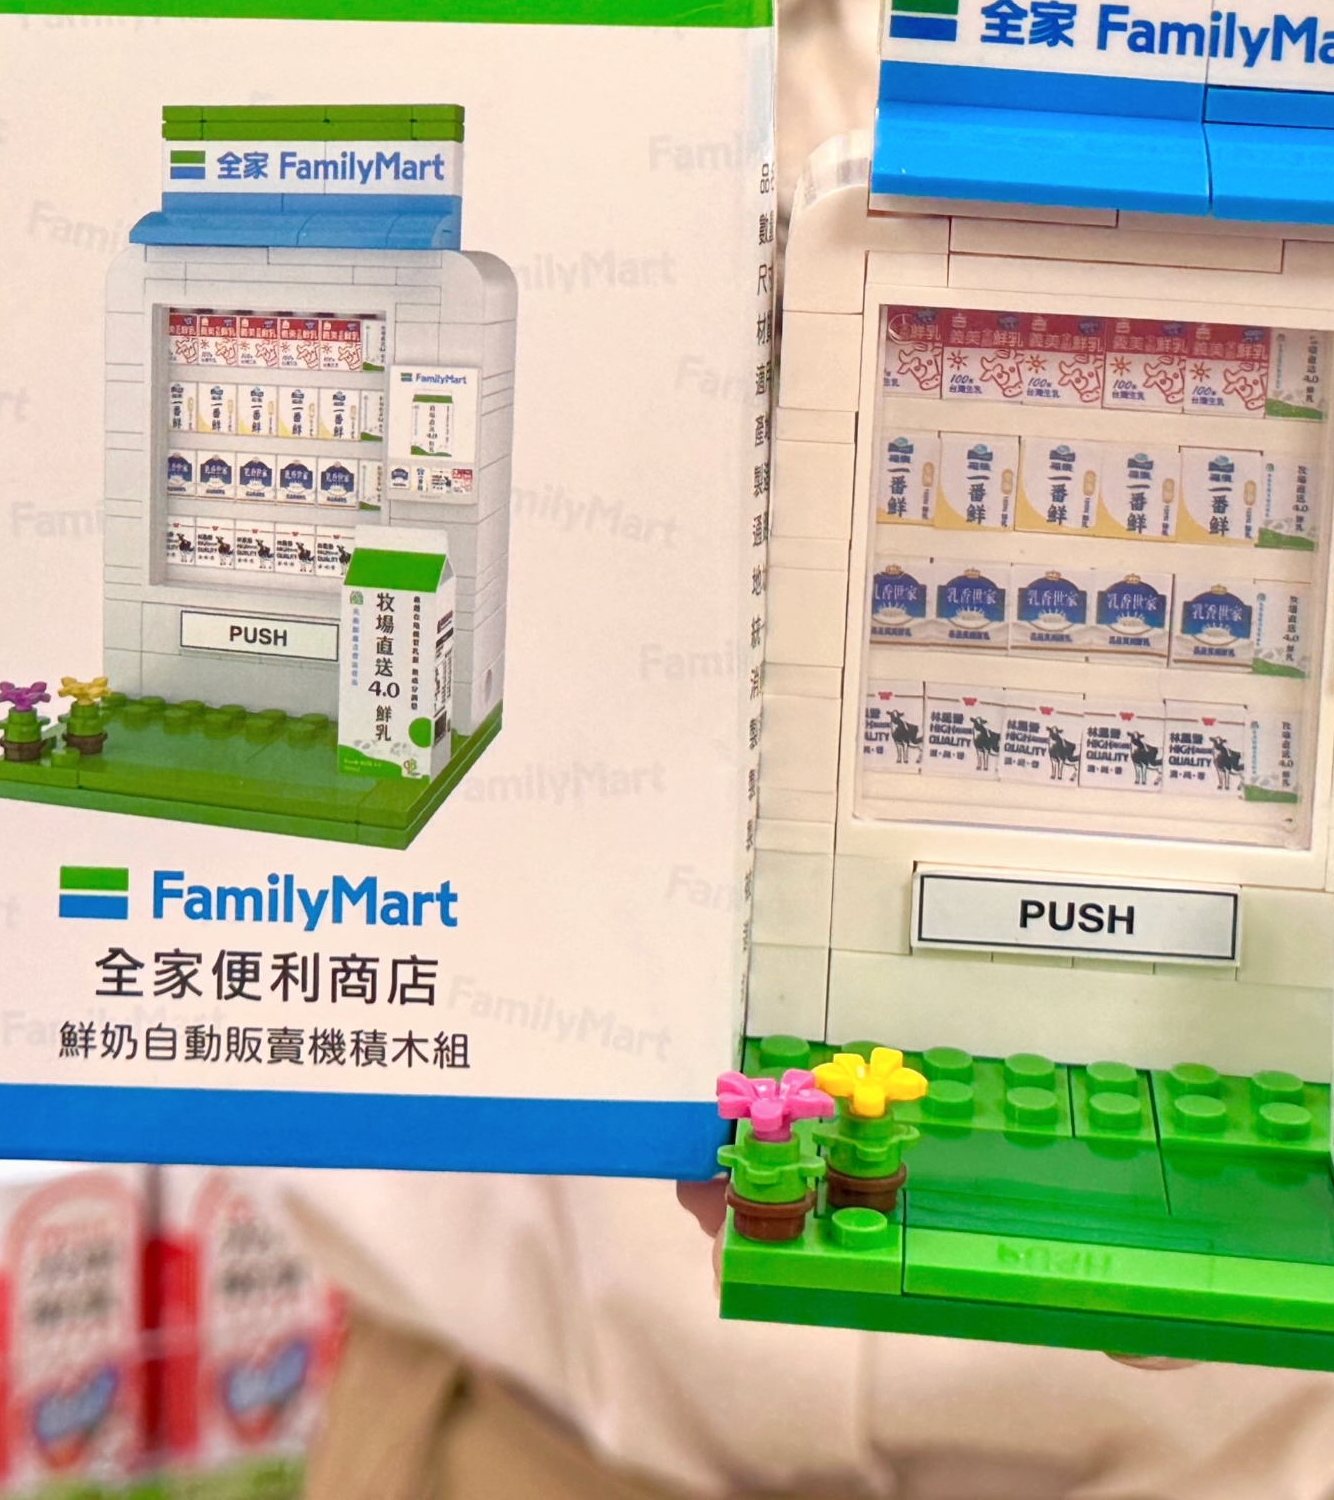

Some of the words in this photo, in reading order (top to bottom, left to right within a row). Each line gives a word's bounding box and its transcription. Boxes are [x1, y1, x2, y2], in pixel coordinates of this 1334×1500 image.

[216, 150, 269, 181] 全家
[280, 152, 446, 183] FamilyMart
[416, 373, 467, 385] FamilyMart
[229, 624, 289, 647] PUSH
[929, 734, 971, 748] QUALITY
[1004, 742, 1047, 757] QUALITY
[1086, 750, 1129, 763] QUALITY
[1168, 756, 1212, 768] QUALITY
[464, 760, 667, 805] amilyMart
[152, 870, 458, 932] FamilyMart
[1019, 898, 1136, 936] PUSH
[94, 947, 439, 1007] 全家便利商店
[447, 974, 673, 1061] FamilyMart
[58, 1022, 472, 1071] 鮮奶自動販賣機積木組
